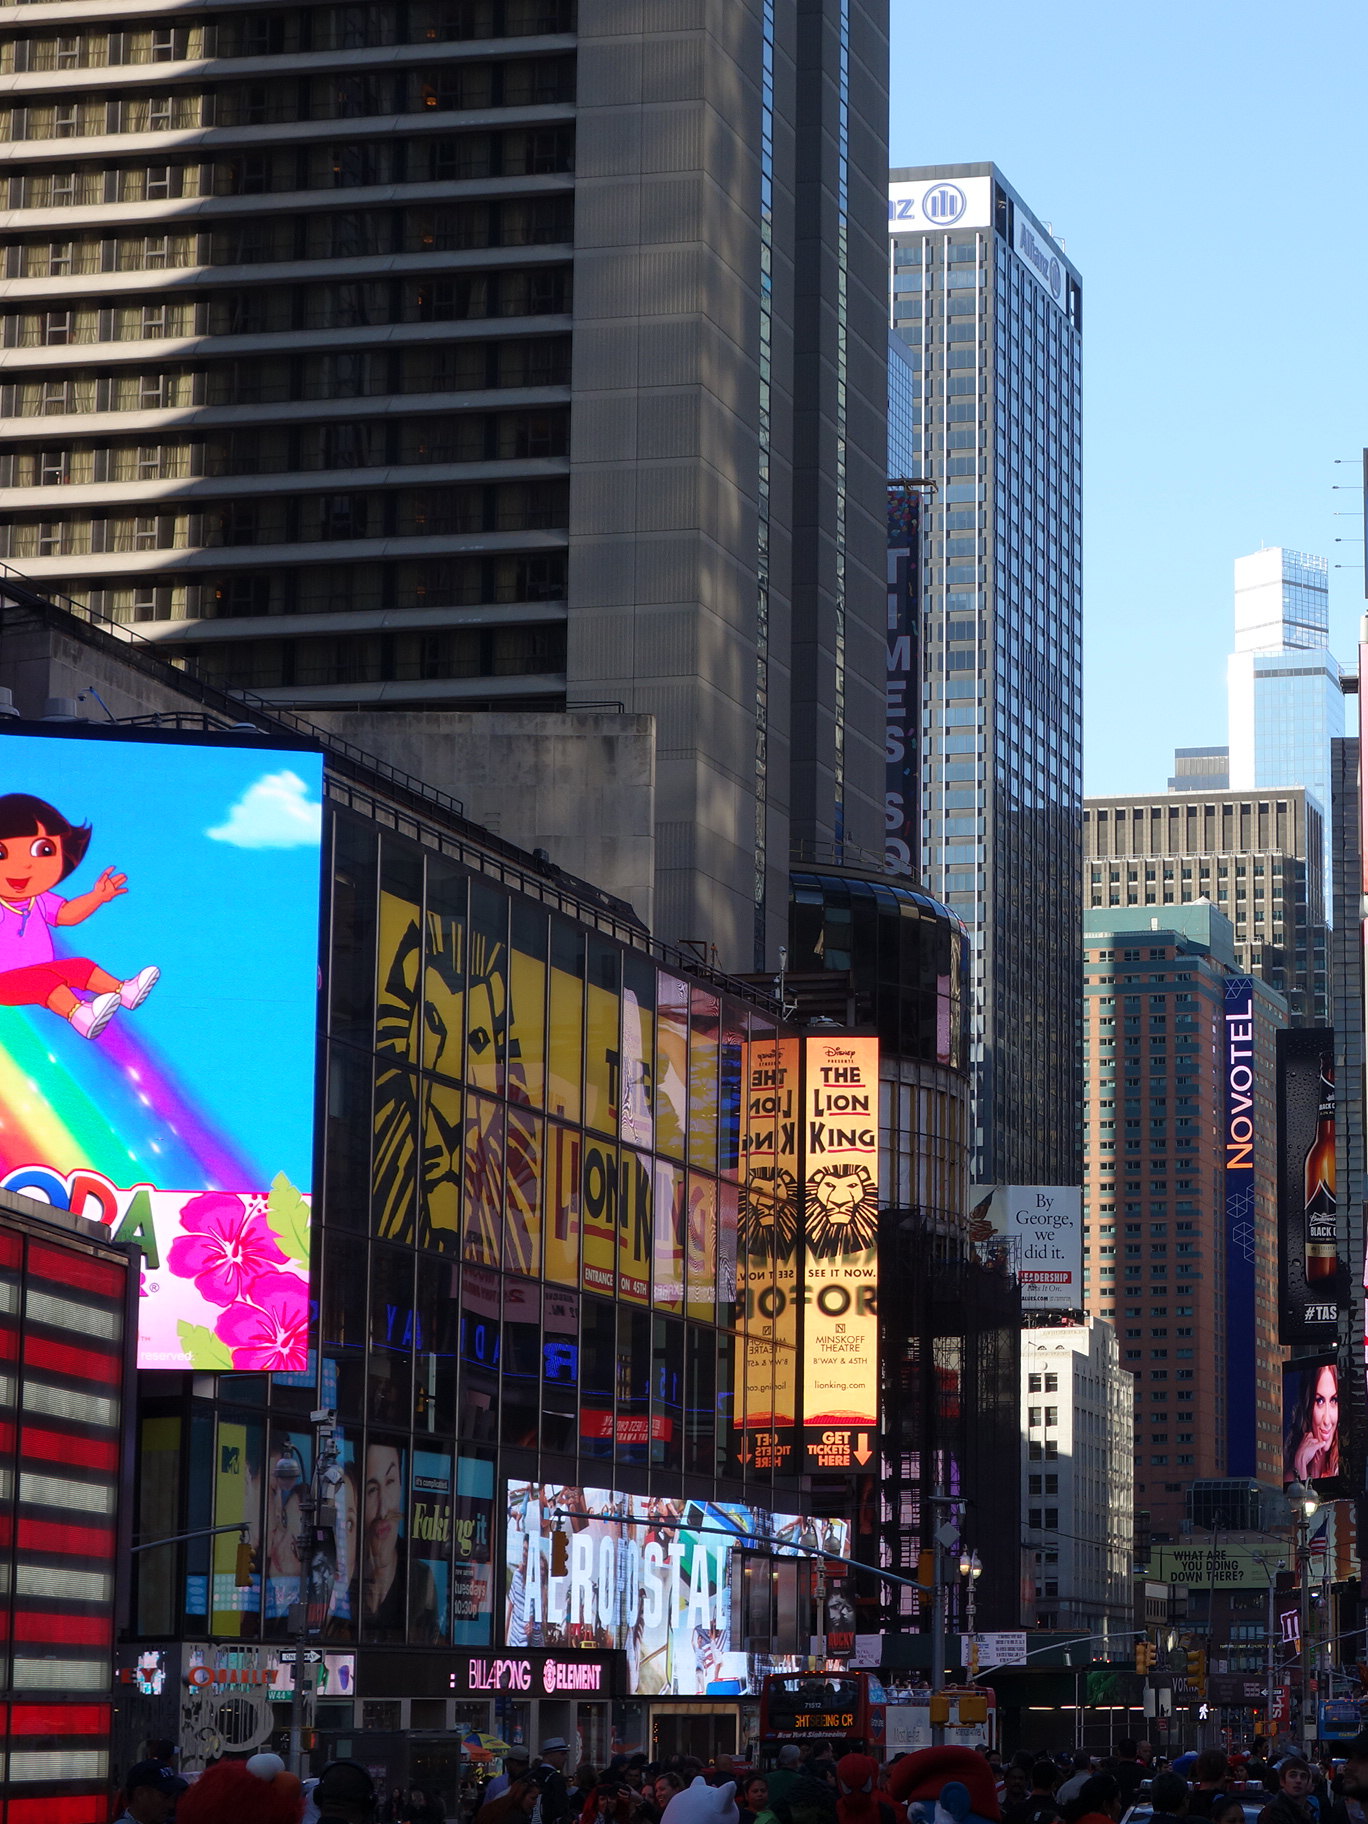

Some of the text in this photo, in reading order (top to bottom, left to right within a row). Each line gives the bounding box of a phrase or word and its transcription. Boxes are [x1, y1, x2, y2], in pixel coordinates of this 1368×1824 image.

[1020, 222, 1049, 282] Allianz
[820, 1067, 861, 1083] THE
[1226, 998, 1254, 1171] NOVOTEL
[814, 1089, 869, 1117] LION
[809, 1121, 875, 1154] KING
[1036, 1193, 1054, 1211] By
[1016, 1210, 1074, 1229] George,
[1035, 1231, 1055, 1241] we
[1310, 1226, 1331, 1237] BLACK
[1024, 1244, 1065, 1259] did it.
[808, 1269, 876, 1278] SEE IT NOW.
[1021, 1272, 1069, 1282] LEADERSHIP
[584, 1268, 614, 1286] ENTRANCE
[620, 1277, 631, 1290] ON
[633, 1280, 647, 1296] 45TH
[1305, 1306, 1337, 1321] #TAS
[821, 1344, 860, 1352] THEATRE
[814, 1382, 866, 1391] lionking.com
[822, 1432, 850, 1444] GET
[807, 1445, 850, 1455] TICKETS
[819, 1456, 850, 1466] HERE
[412, 1503, 487, 1556] Faking it
[1174, 1551, 1227, 1561] WHAT ARE
[1181, 1560, 1239, 1571] YOU DOING
[1170, 1571, 1244, 1583] DOWN THERE?
[455, 1580, 487, 1597] tuesdays
[188, 1666, 279, 1687] OAKLEY
[469, 1659, 601, 1690] BILLABONG ELEMENT
[268, 1691, 286, 1699] W 44
[842, 1714, 854, 1726] CR
